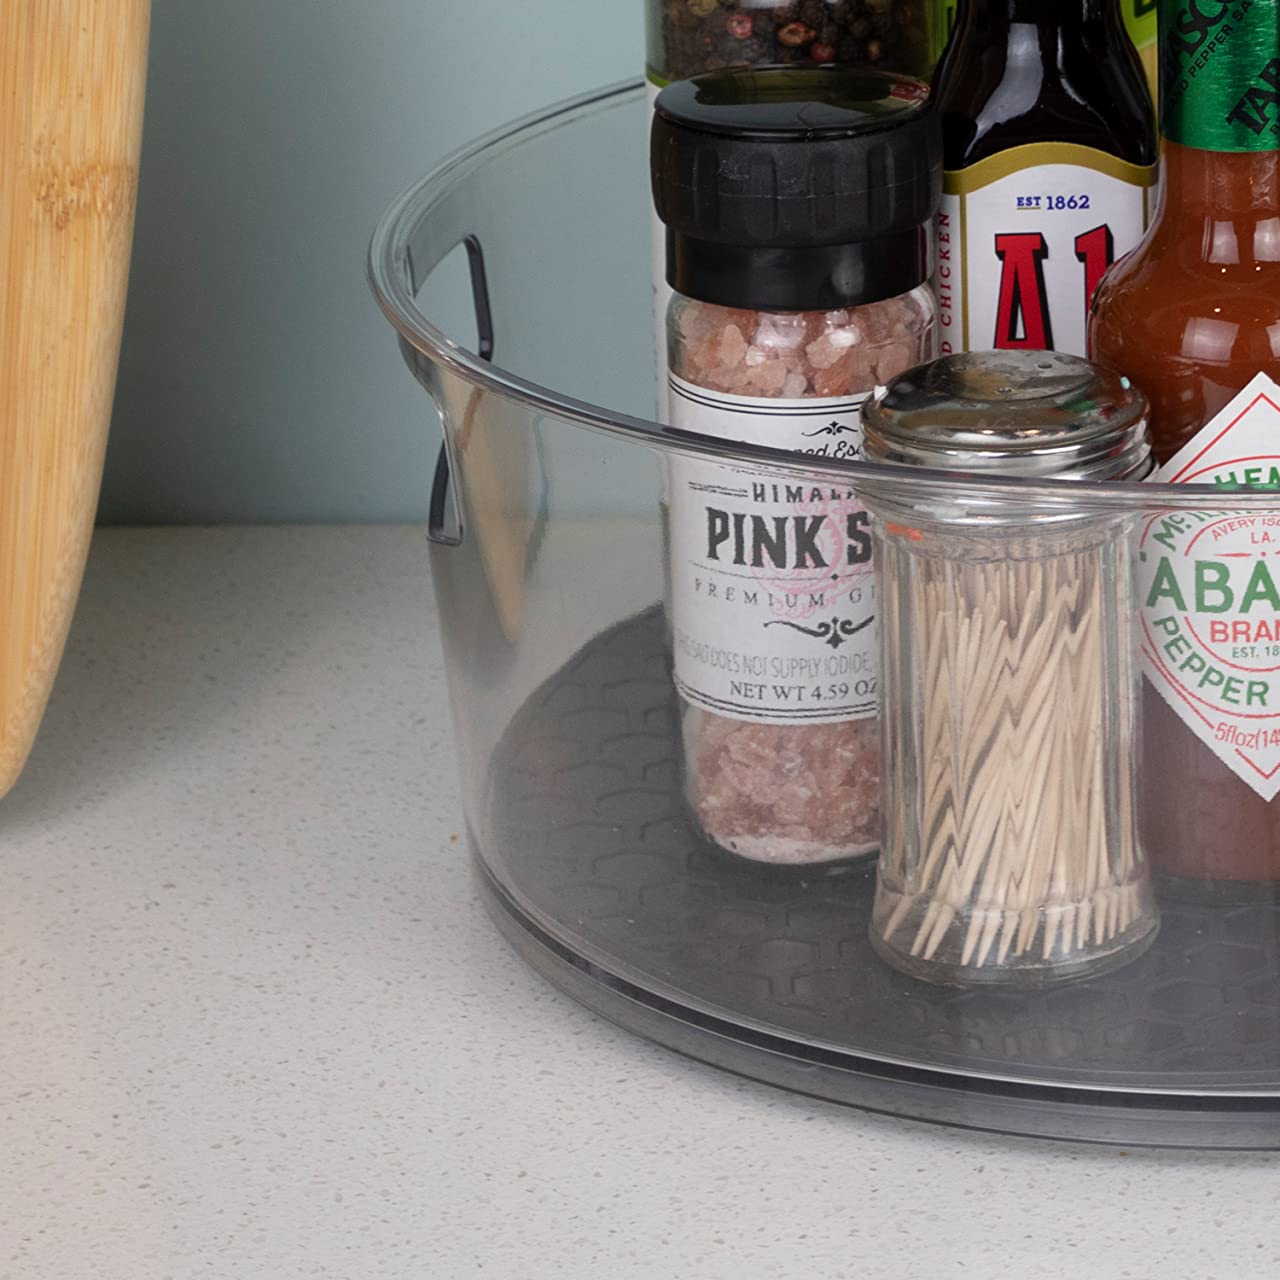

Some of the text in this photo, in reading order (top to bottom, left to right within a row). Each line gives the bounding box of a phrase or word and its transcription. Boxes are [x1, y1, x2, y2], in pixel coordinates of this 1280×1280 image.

[1188, 23, 1233, 77] PEPPER
[1016, 195, 1090, 210] EST 1862
[939, 212, 952, 327] CHICKEN
[706, 506, 829, 569] PINK
[1212, 518, 1257, 541] AVERY
[1250, 531, 1276, 545] LA.
[695, 577, 825, 608] PREMIUM
[1152, 615, 1269, 707] PEPPER
[1232, 646, 1259, 658] EST.
[771, 656, 821, 679] SUPPLY
[730, 680, 767, 700] NET
[773, 685, 806, 701] WT
[811, 683, 848, 701] 4.59
